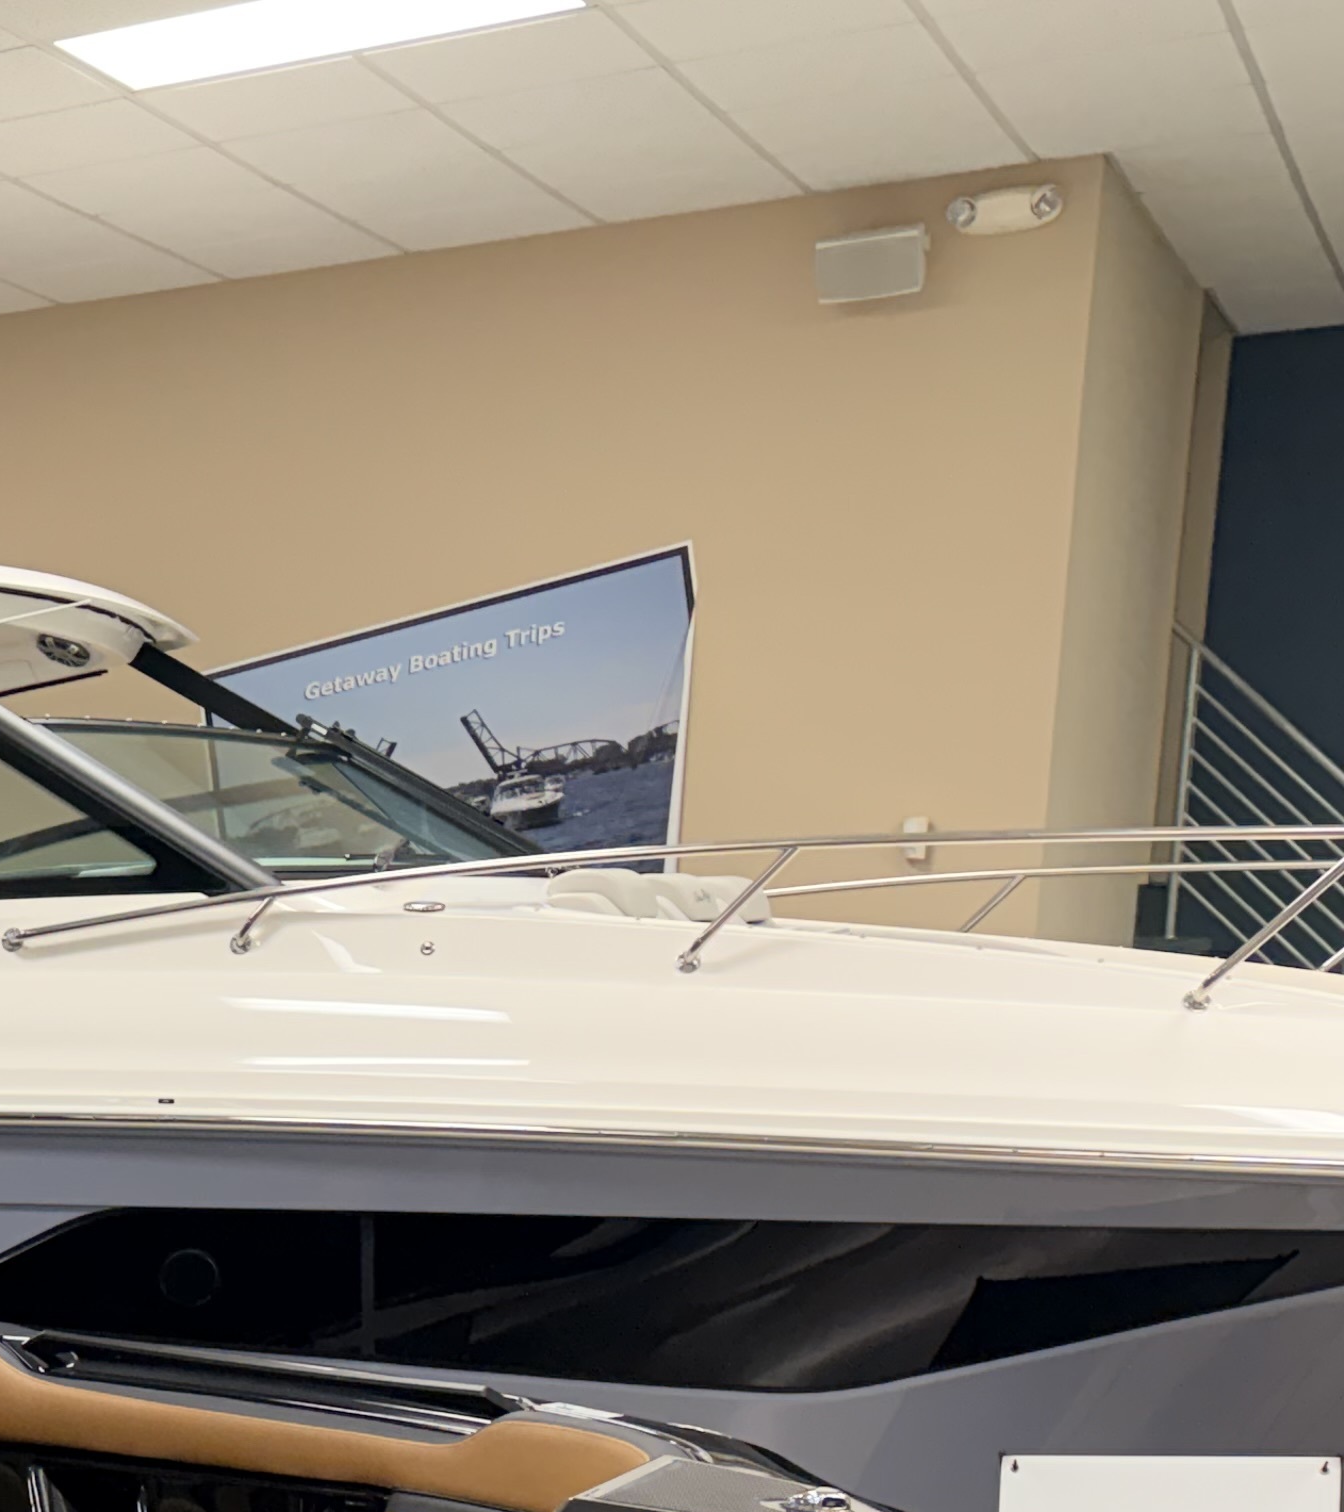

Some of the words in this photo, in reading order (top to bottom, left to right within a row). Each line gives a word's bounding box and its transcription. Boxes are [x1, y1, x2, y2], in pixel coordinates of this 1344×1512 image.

[304, 663, 402, 700] Getaway
[409, 638, 498, 673] Boating
[505, 621, 565, 648] Trips
